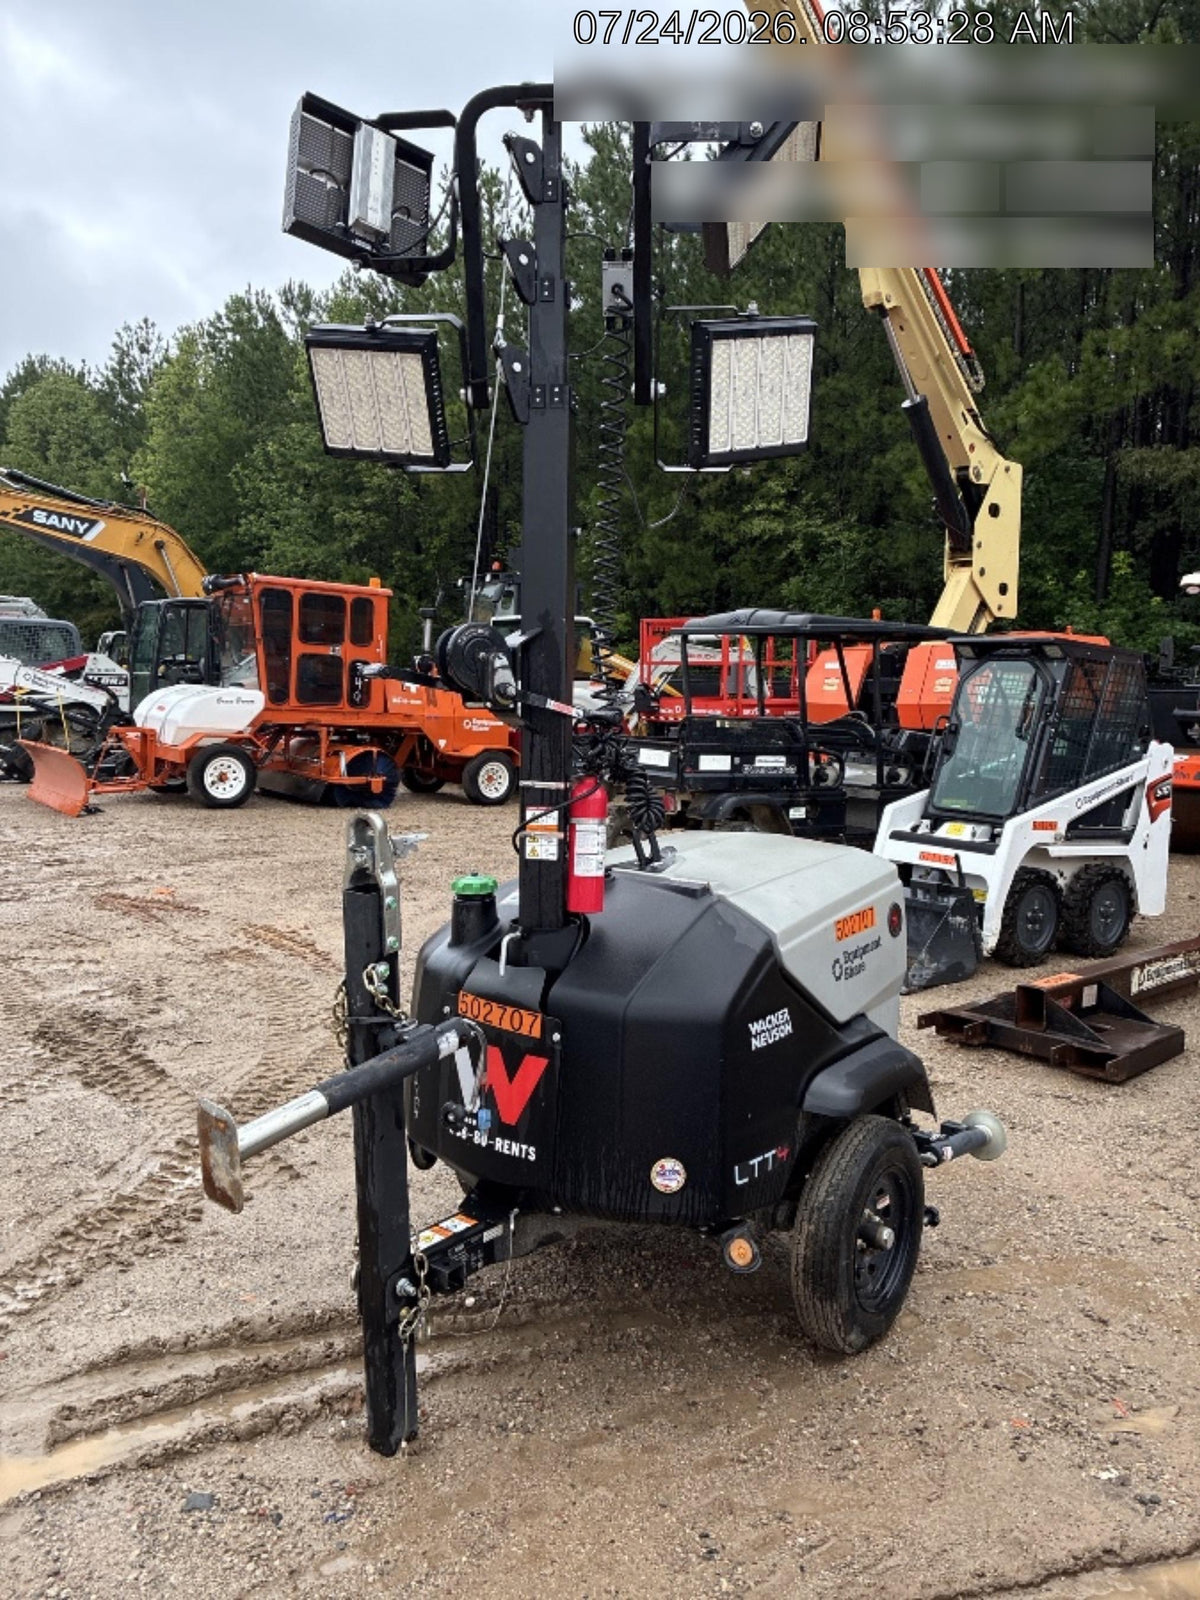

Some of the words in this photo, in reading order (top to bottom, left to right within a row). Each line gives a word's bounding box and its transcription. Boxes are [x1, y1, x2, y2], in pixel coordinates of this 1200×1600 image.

[33, 509, 89, 534] SANY
[460, 991, 539, 1036] 502707
[748, 1008, 790, 1035] WACKER
[751, 1021, 793, 1051] NEUSON
